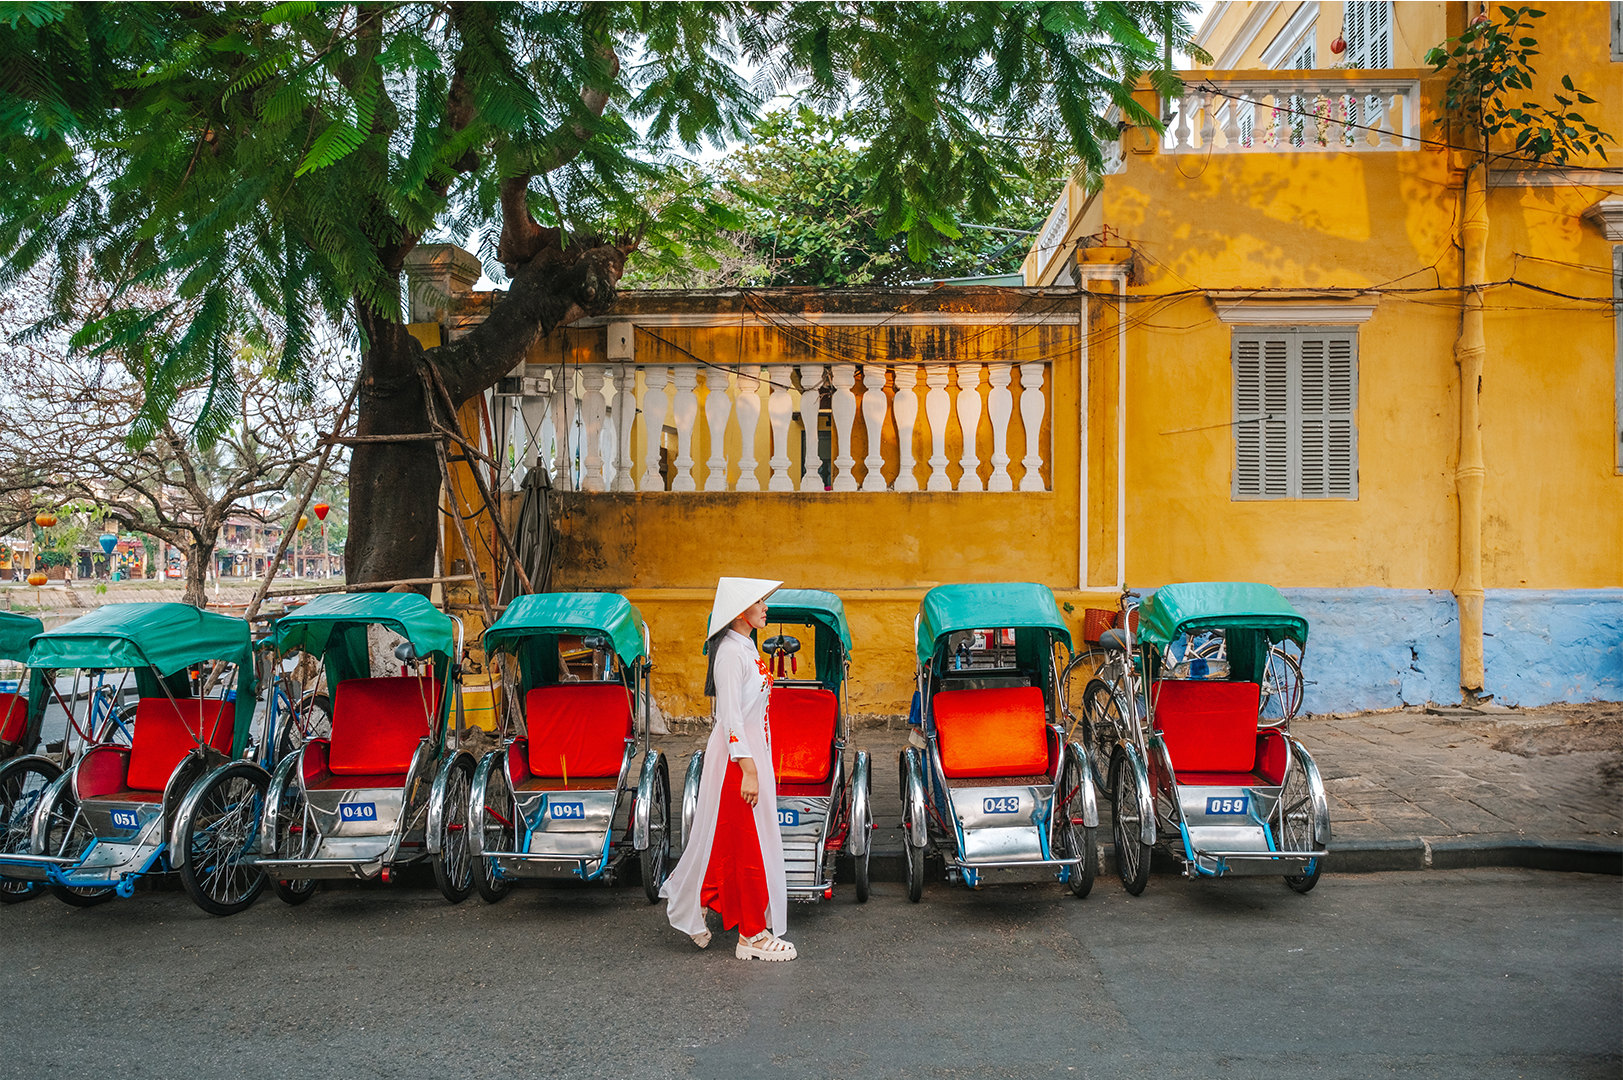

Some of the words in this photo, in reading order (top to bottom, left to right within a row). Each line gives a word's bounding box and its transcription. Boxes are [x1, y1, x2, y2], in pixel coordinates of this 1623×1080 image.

[553, 805, 581, 817] 091
[984, 797, 1019, 812] 043
[1211, 799, 1243, 812] 059
[343, 806, 373, 817] 040
[114, 812, 137, 826] 051
